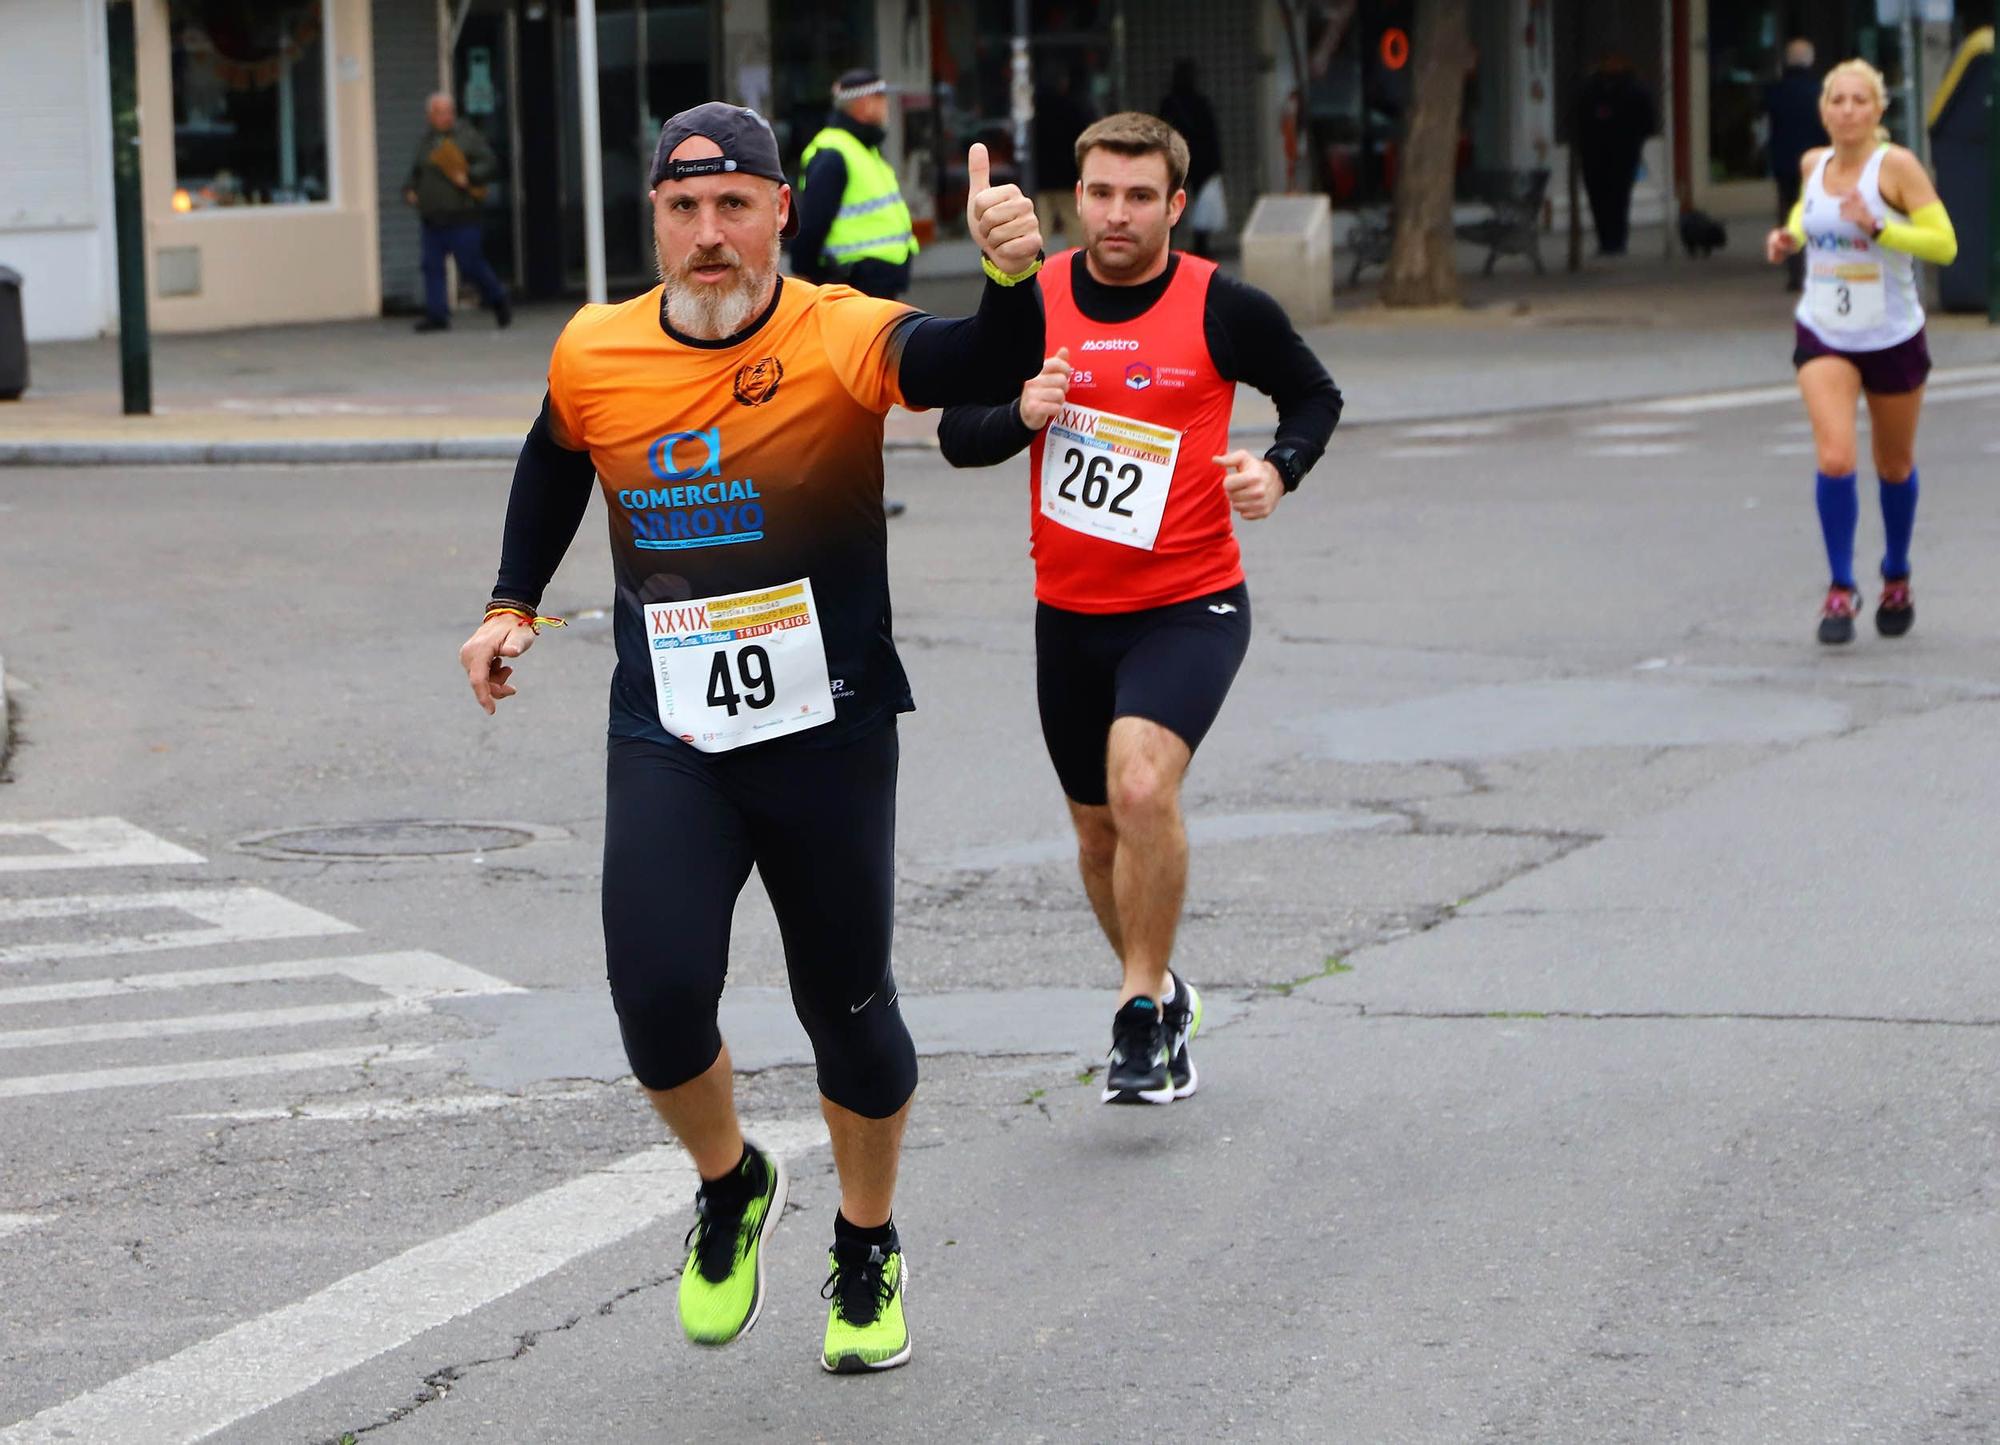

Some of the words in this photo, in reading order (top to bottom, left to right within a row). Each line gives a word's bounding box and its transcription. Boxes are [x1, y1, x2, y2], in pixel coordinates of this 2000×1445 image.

[675, 163, 721, 173] Kalenji
[1837, 286, 1851, 316] 3
[1114, 444, 1170, 465] TRINITARIOS
[619, 479, 760, 509] COMERCIAL
[1058, 447, 1143, 518] 262
[630, 503, 765, 540] ARROYO
[651, 605, 709, 635] XXXIX
[738, 614, 811, 639] TRINITARIOS
[700, 631, 731, 643] Trinidad
[706, 644, 776, 717] 49
